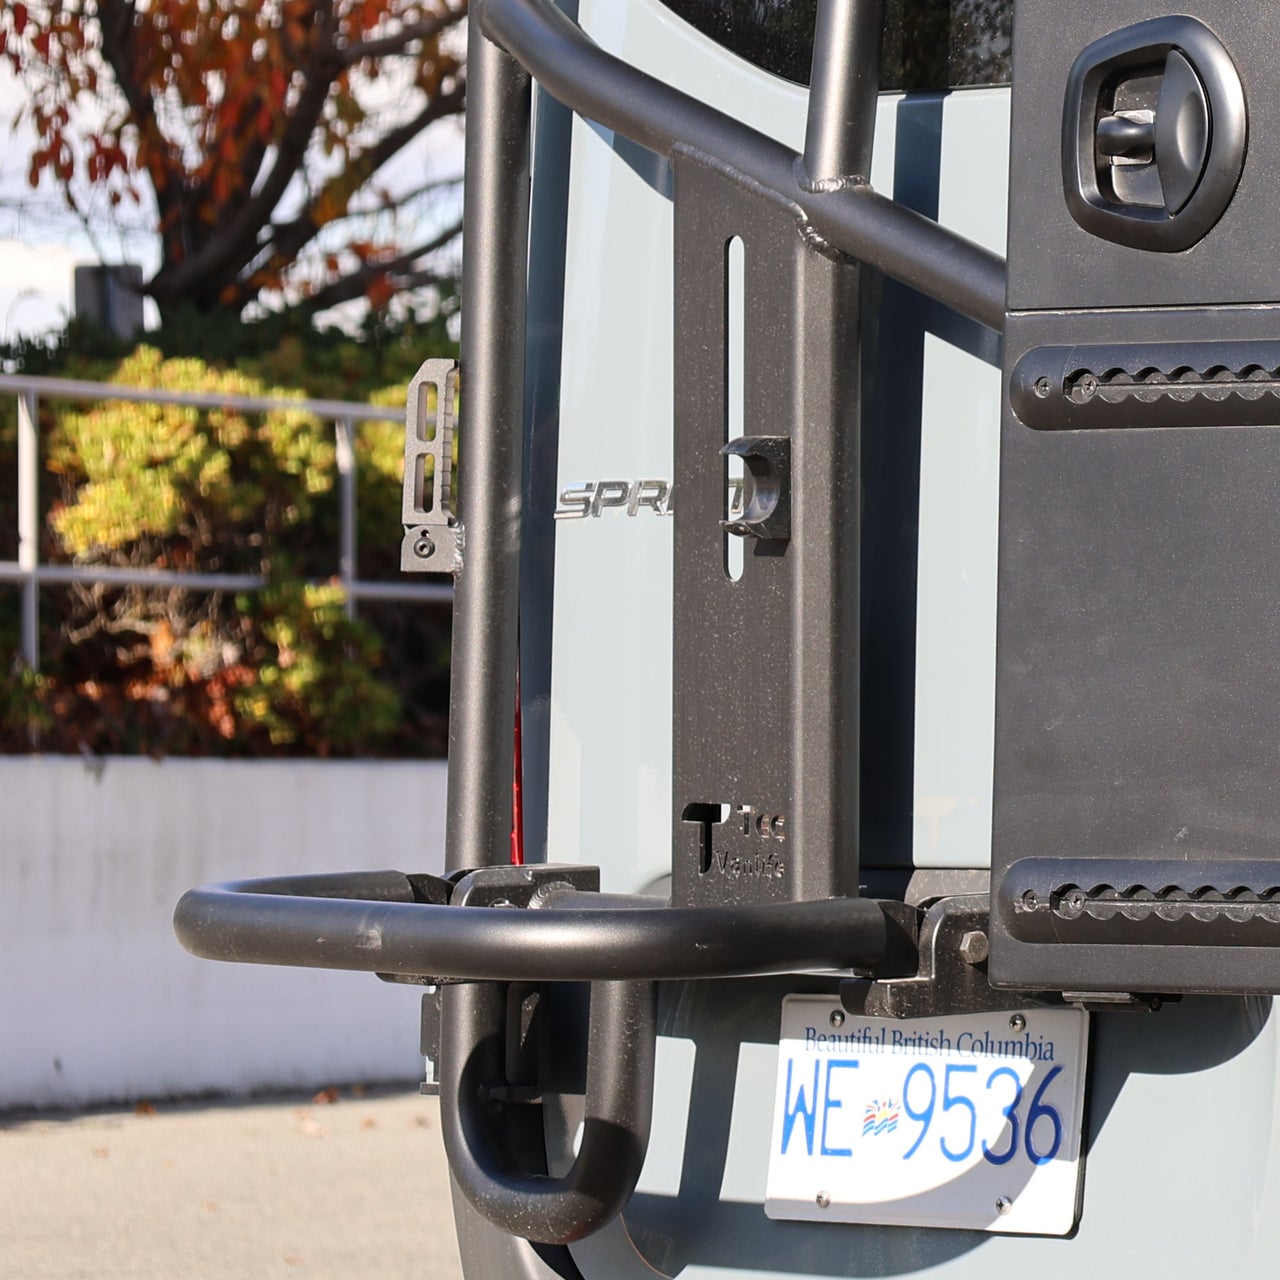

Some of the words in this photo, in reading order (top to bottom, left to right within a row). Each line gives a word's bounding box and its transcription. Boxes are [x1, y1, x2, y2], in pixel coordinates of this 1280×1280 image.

[805, 1026, 886, 1055] Beautiful
[892, 1029, 950, 1057] British
[957, 1032, 1054, 1062] Columbia
[780, 1058, 859, 1157] WE
[903, 1062, 1064, 1166] 9536
